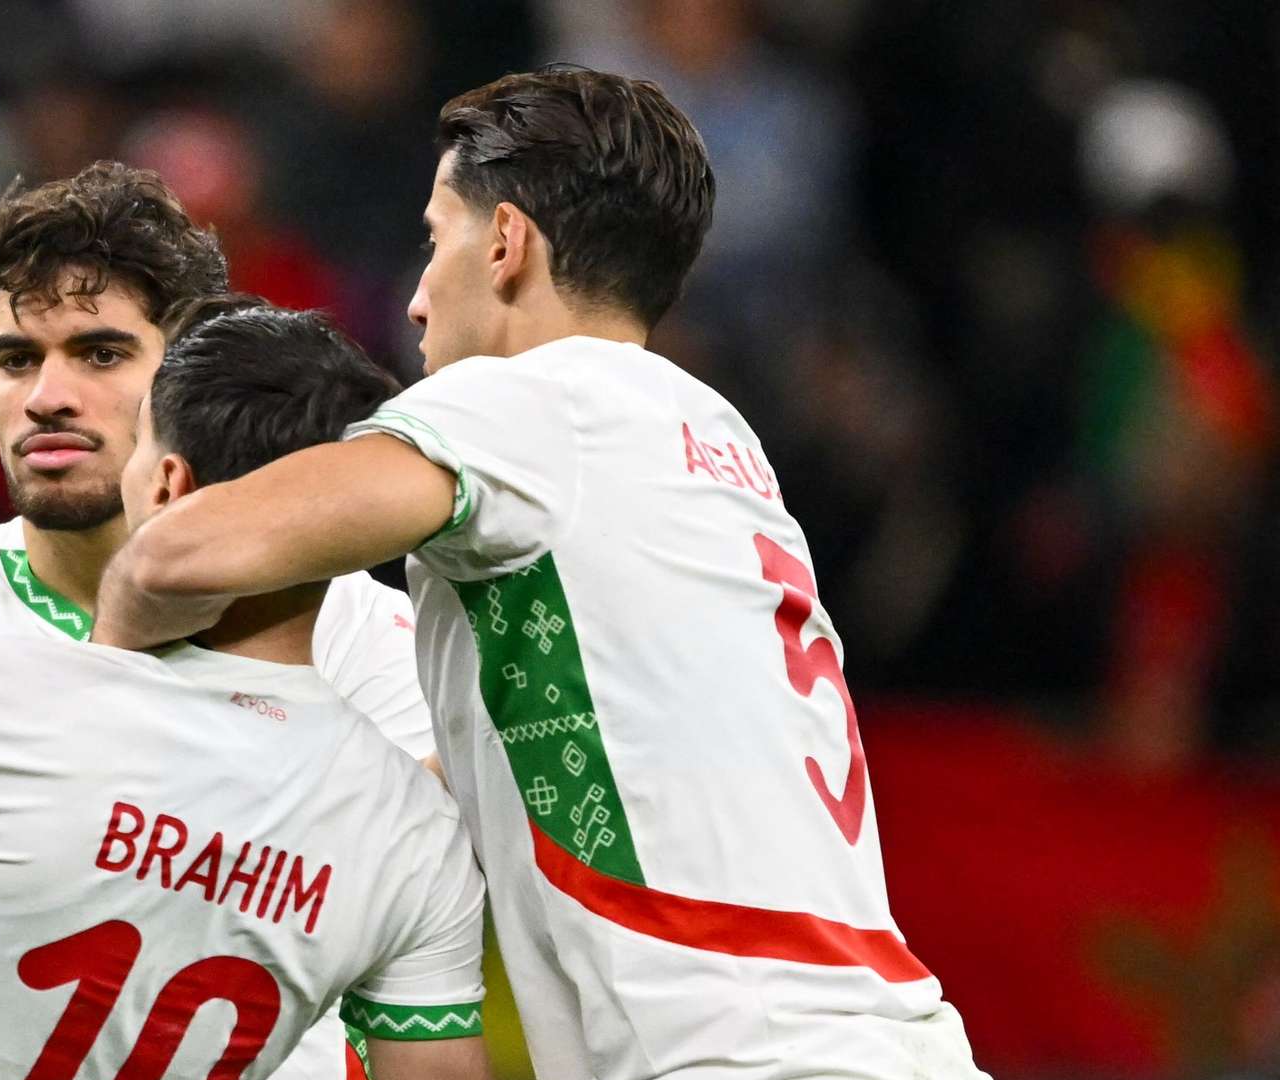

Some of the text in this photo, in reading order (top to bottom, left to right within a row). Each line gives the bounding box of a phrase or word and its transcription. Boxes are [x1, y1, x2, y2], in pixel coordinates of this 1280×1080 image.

[681, 421, 783, 501] AGU
[753, 532, 866, 848] 5
[94, 801, 333, 934] BRAHIM
